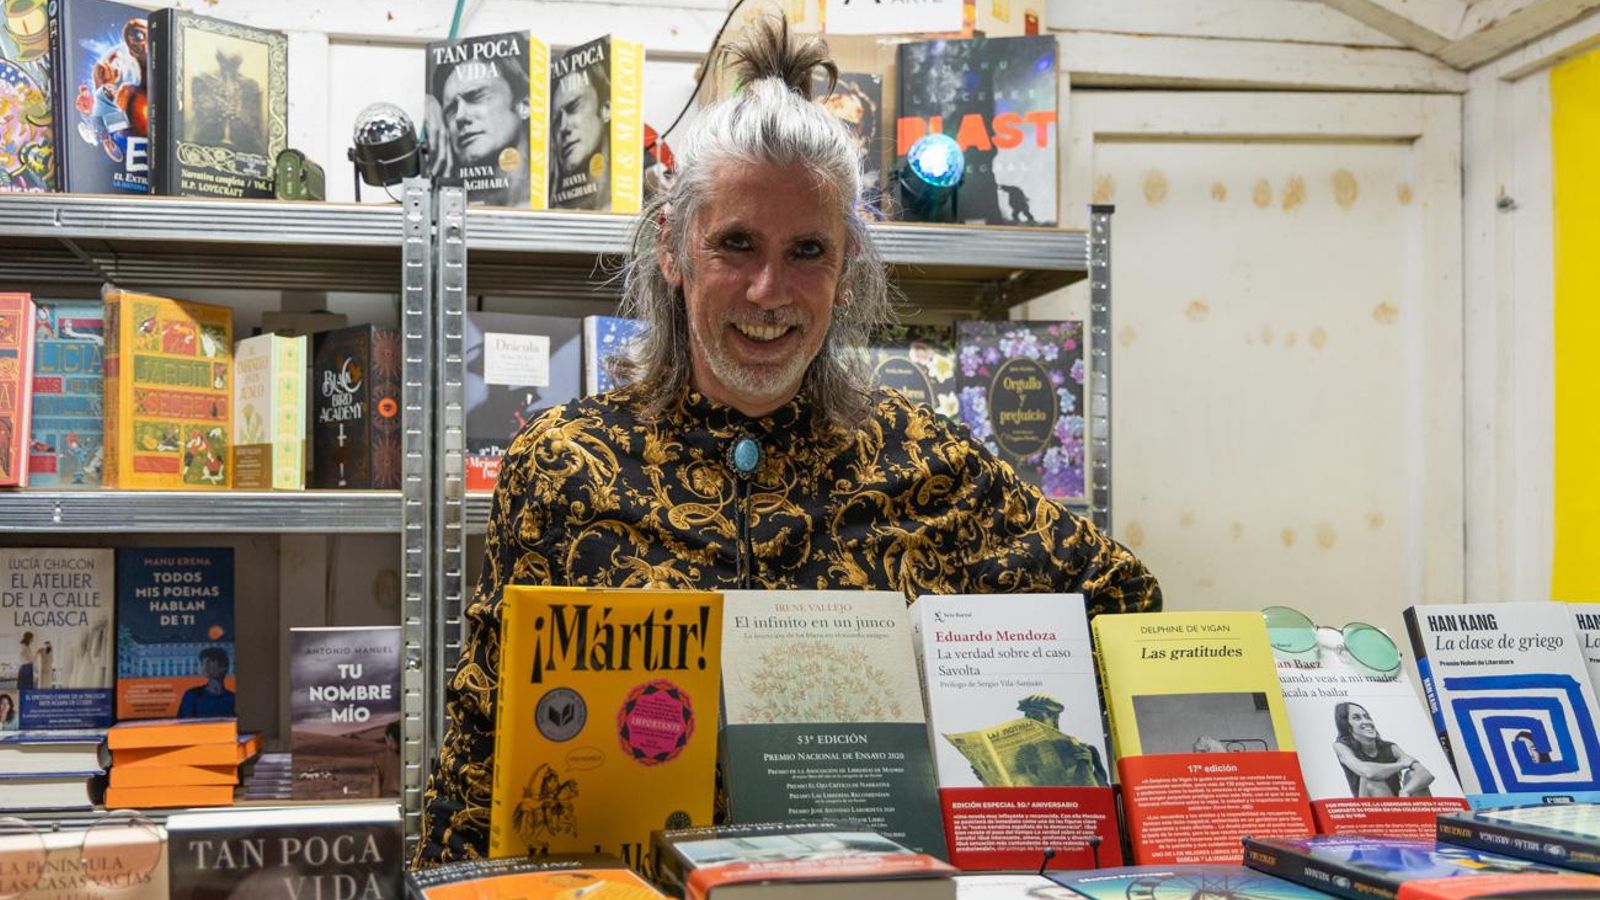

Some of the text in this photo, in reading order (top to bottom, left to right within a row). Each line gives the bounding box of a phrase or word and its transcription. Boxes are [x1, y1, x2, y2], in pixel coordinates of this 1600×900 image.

[433, 38, 520, 65] TAN POCA
[571, 45, 605, 75] POCA
[455, 61, 499, 81] VIDA
[559, 70, 590, 94] VIDA
[182, 169, 214, 182] Narrativa
[215, 175, 245, 187] completa
[459, 165, 493, 179] HANYA
[198, 182, 244, 197] LOVECRAFT
[495, 338, 540, 353] Drácula
[1003, 376, 1042, 393] Orgullo
[1019, 394, 1027, 408] y
[319, 402, 362, 424] ACADEMY
[1000, 407, 1046, 425] prejuicio
[9, 556, 94, 570] LUCÍA CHACÓN
[144, 557, 175, 566] MANU
[12, 573, 92, 589] EL ATELIER
[153, 572, 202, 583] TODOS
[135, 586, 220, 598] MIS POEMAS
[2, 592, 101, 608] DE LA CALLE
[149, 600, 206, 611] HABLAN
[775, 603, 852, 614] IRENE VALLEJO
[14, 611, 88, 627] LAGASCA
[160, 615, 196, 626] DE TI
[735, 616, 896, 632] El infinito en un junco
[1428, 614, 1498, 632] HAN KANG
[935, 629, 1057, 643] Eduardo Mendoza
[1141, 624, 1231, 634] DELPHINE DE VIGAN
[530, 604, 711, 684] ¡Mártir!
[1436, 633, 1564, 652] La clase de griego
[304, 646, 393, 656] ANTONIO MANUEL
[937, 647, 1071, 659] La verdad sobre el caso
[1141, 645, 1243, 660] Las gratitudes
[338, 663, 363, 680] TU
[938, 665, 981, 676] Savolta
[1277, 659, 1322, 669] an Baez
[1279, 674, 1313, 683] uando
[1349, 675, 1364, 683] mi
[309, 684, 392, 702] NOMBRE
[1282, 687, 1349, 698] ácala a bailar
[331, 704, 371, 723] MÍO
[817, 732, 868, 744] EDICIÓN
[763, 752, 796, 761] PREMIO
[798, 752, 840, 760] NACIONAL
[842, 752, 854, 760] DE
[855, 751, 886, 760] ENSAYO
[1204, 764, 1238, 774] edición
[952, 801, 981, 809] EDICIÓN
[189, 838, 266, 870] TAN
[278, 833, 384, 867] POCA
[27, 857, 123, 875] PENÍNSULA
[32, 874, 88, 891] CASAS
[283, 872, 385, 900] VIDA
